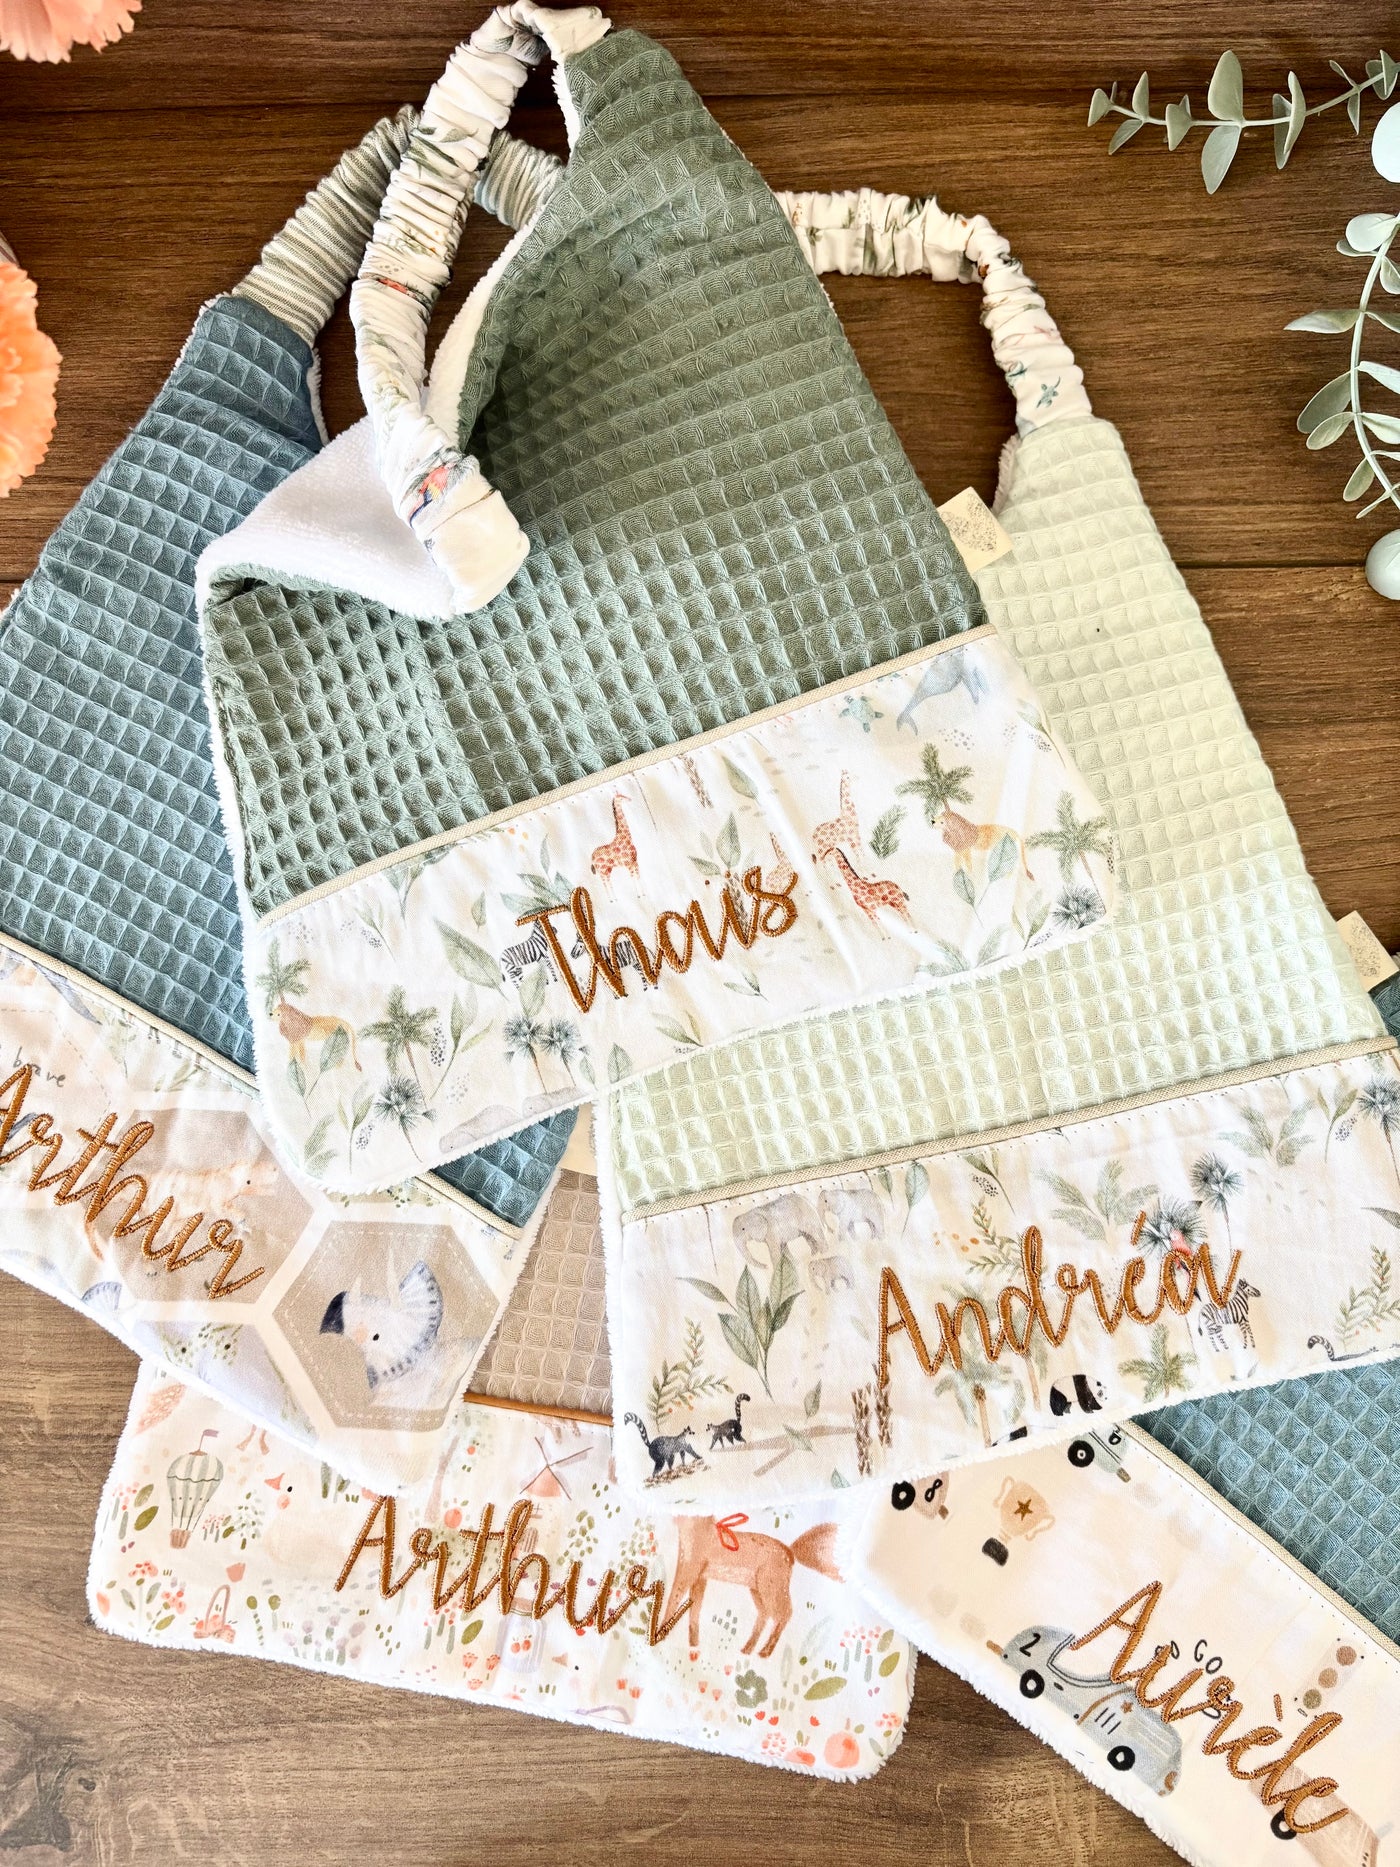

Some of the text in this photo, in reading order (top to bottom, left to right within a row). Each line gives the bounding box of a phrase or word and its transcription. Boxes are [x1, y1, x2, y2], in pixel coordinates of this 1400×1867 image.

[13, 1046, 66, 1088] bave
[0, 1062, 266, 1300] Arthur
[924, 1478, 943, 1503] 8
[335, 1494, 694, 1647] Arthur
[1019, 1632, 1041, 1657] 2
